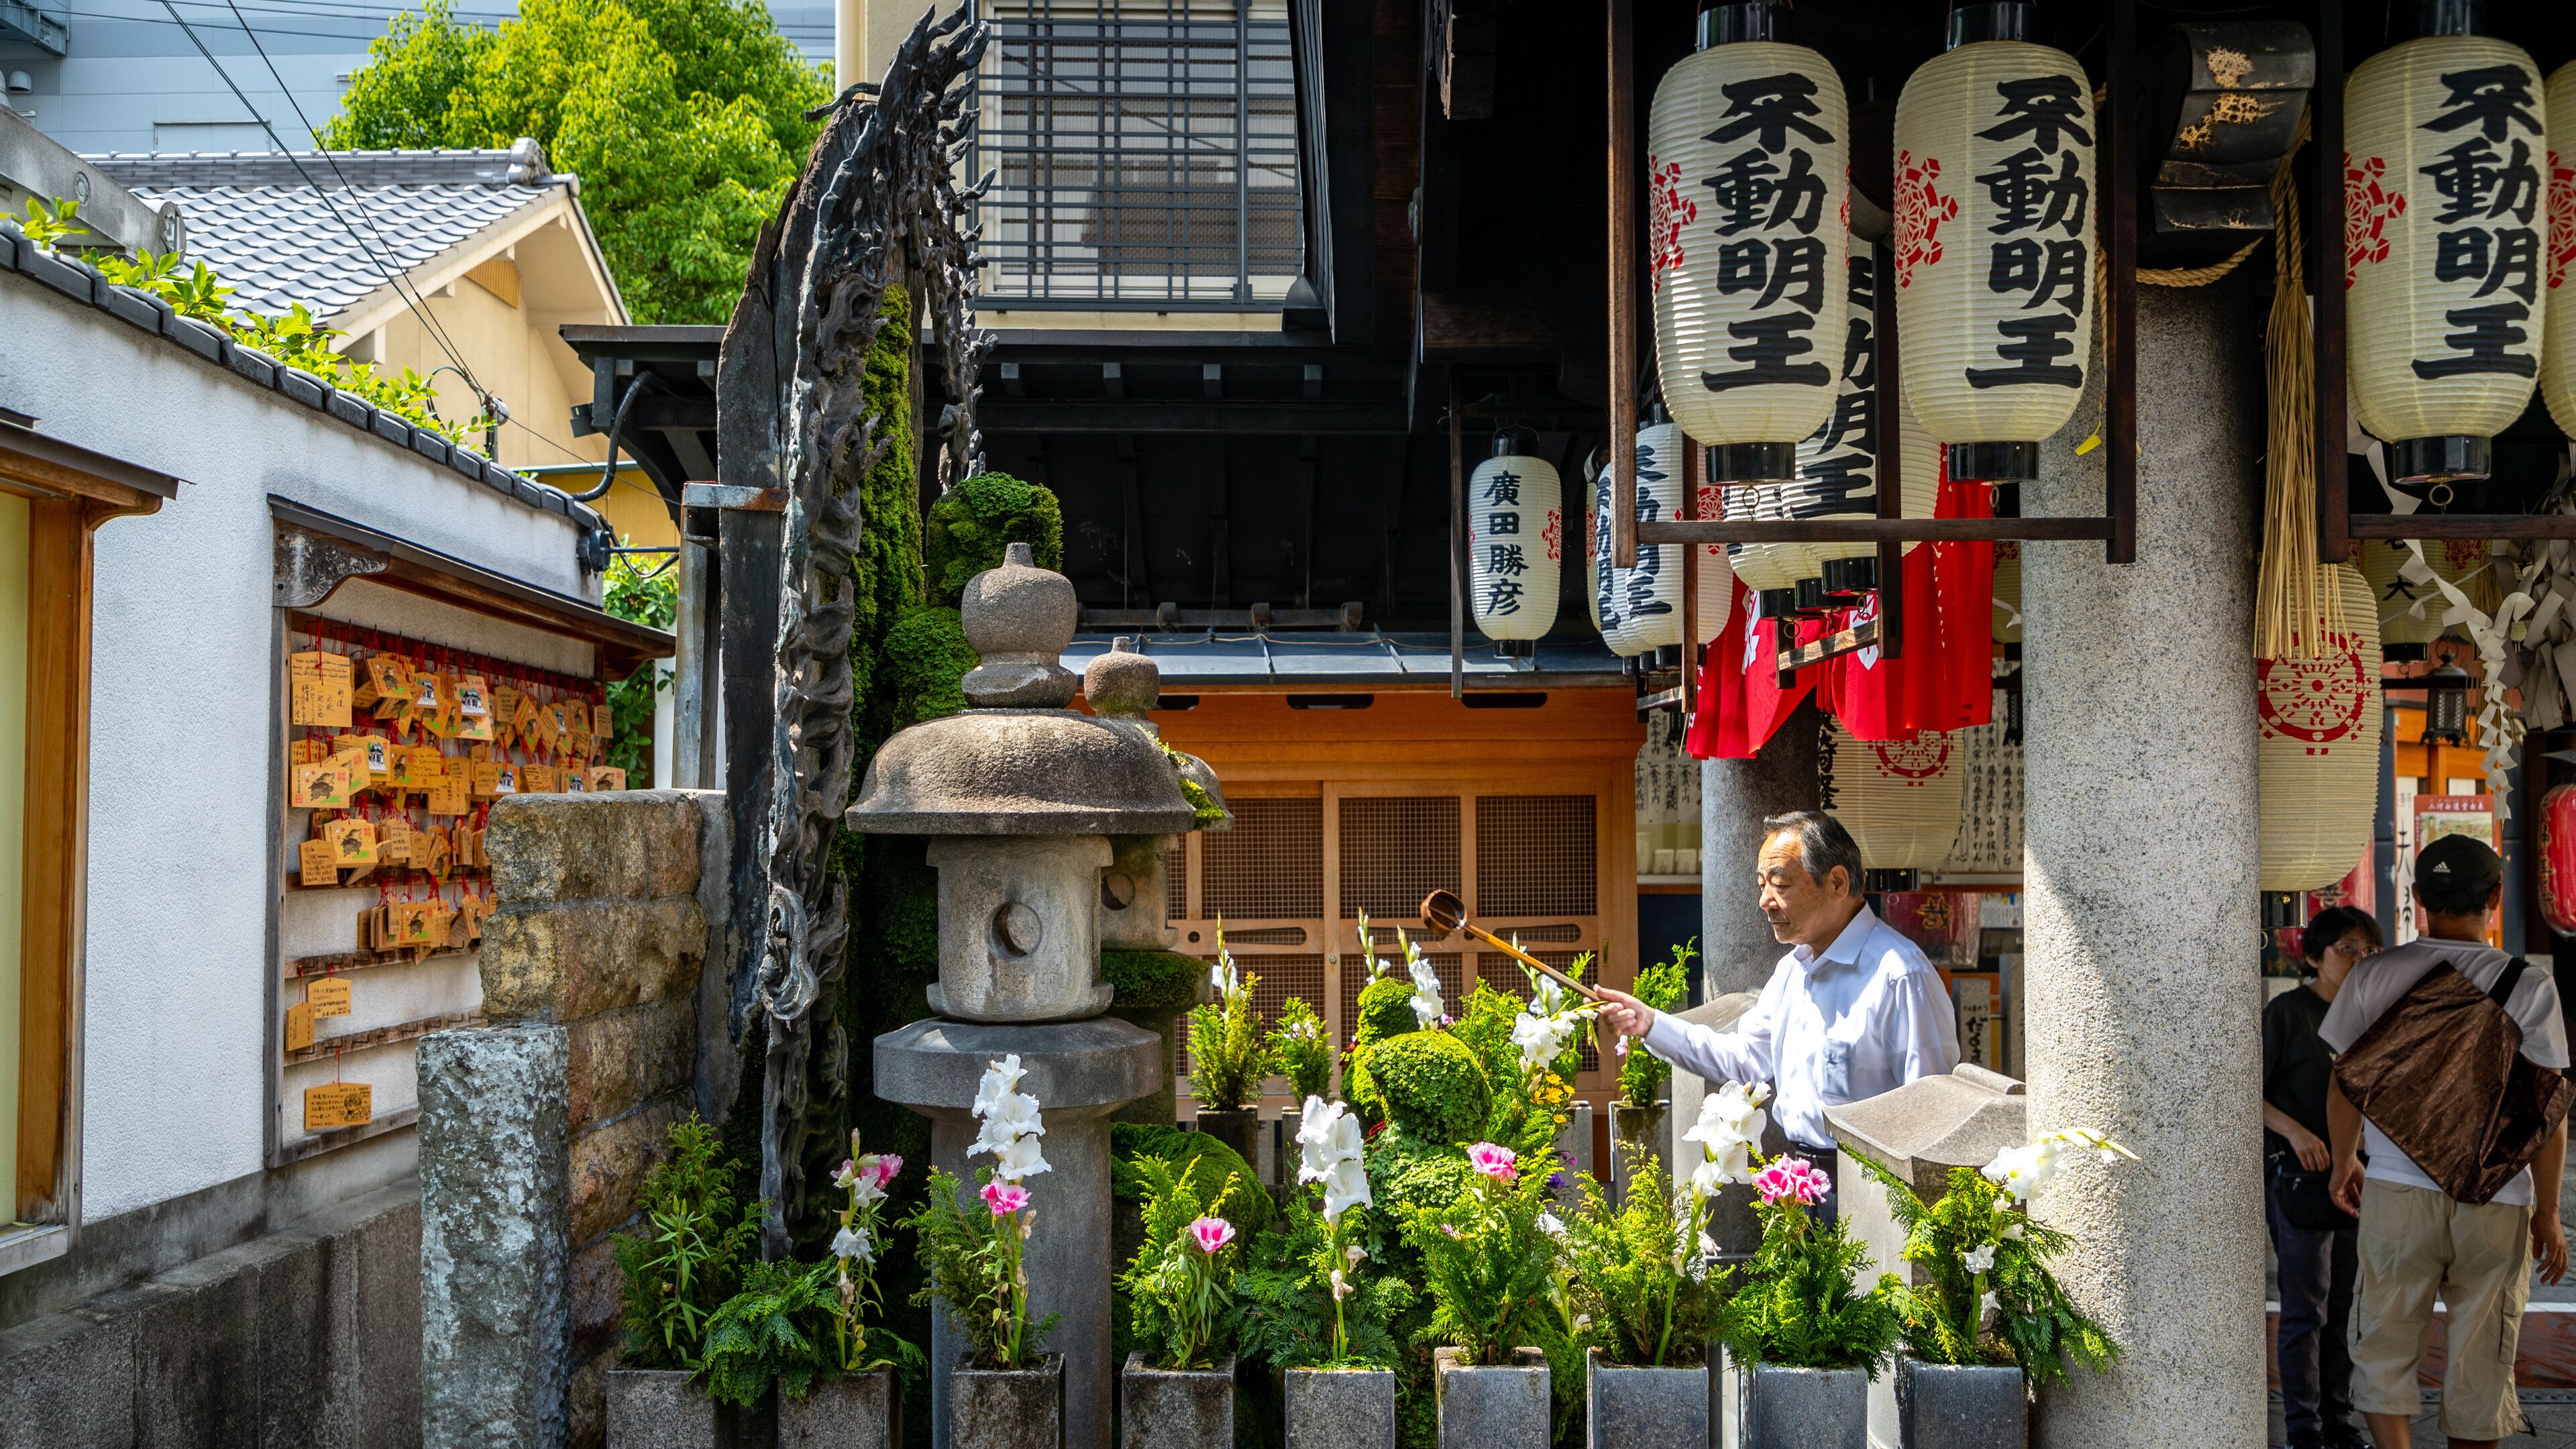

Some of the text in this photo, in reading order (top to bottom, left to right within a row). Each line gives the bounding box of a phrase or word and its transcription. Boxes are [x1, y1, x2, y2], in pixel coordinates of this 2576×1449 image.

[1700, 72, 1836, 392] 不動明王
[1964, 74, 2094, 389] 不動明王
[2411, 64, 2544, 380] 不動明王
[1483, 470, 1529, 616] 廣田勝彦
